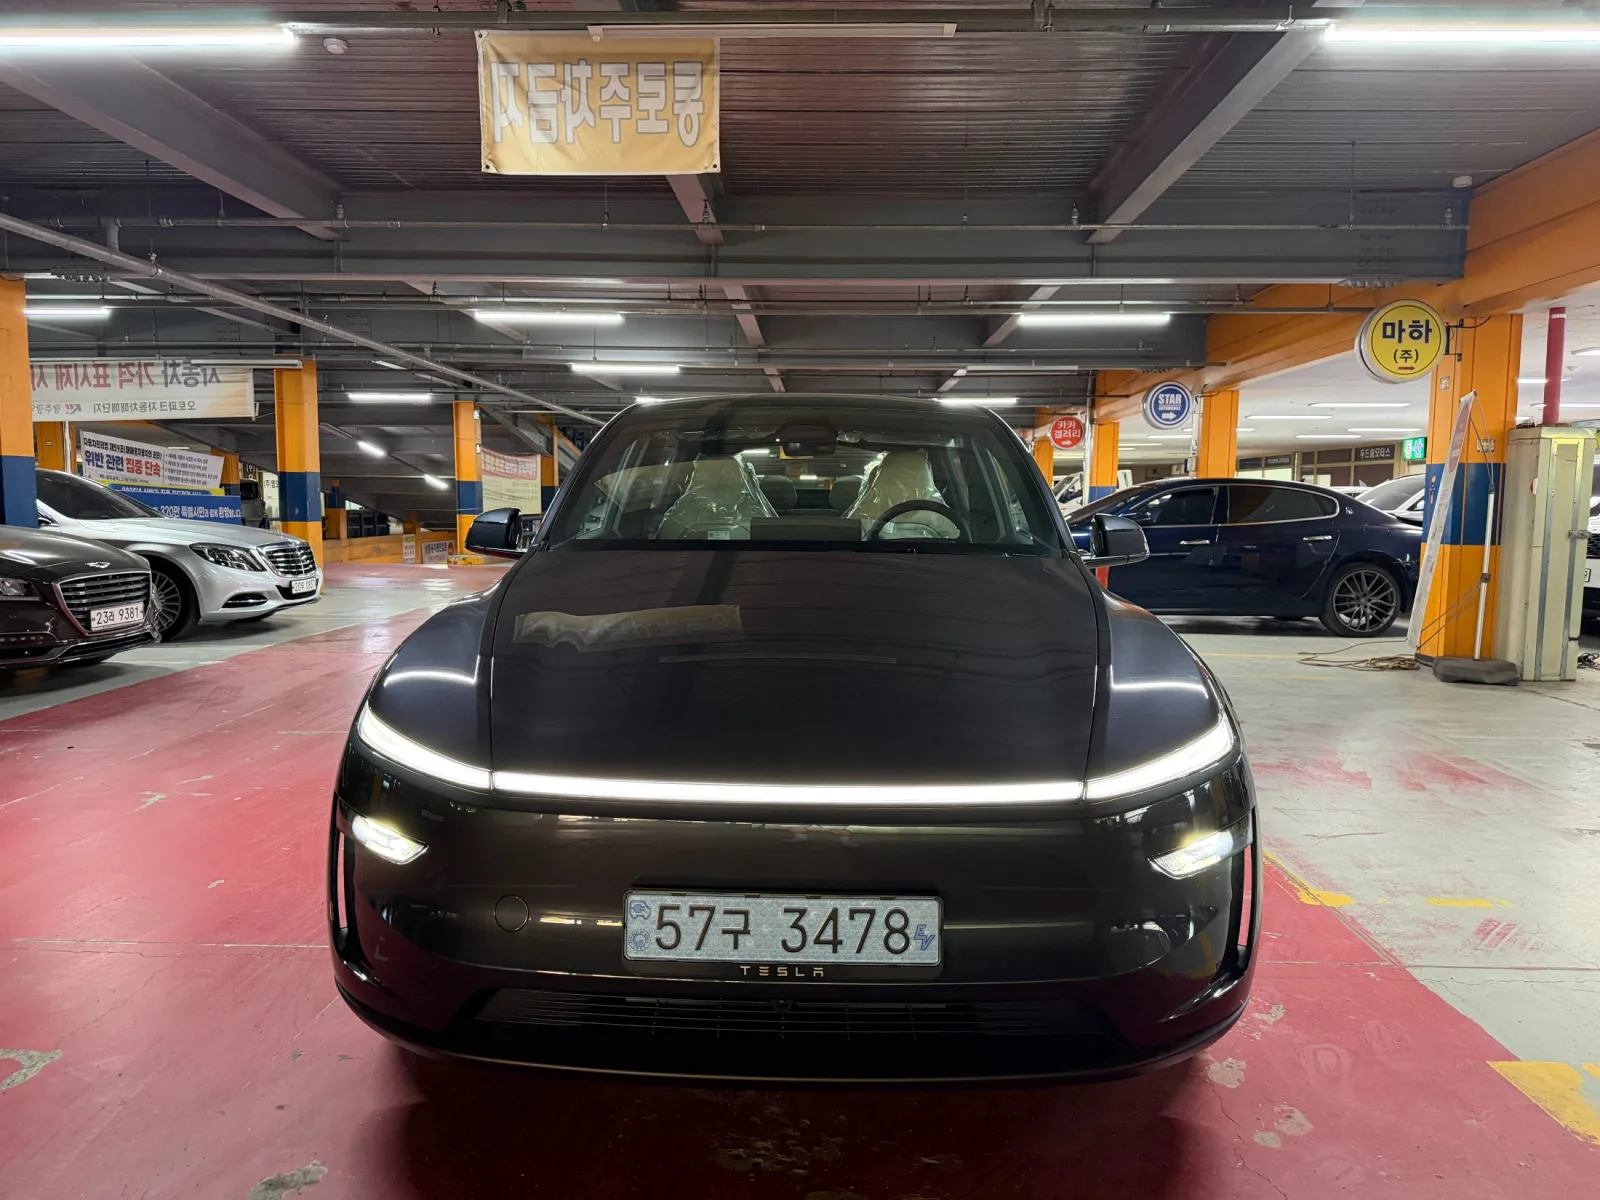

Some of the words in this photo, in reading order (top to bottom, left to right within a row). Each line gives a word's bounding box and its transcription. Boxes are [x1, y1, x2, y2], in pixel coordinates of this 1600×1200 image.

[1382, 319, 1432, 343] 마하
[1393, 348, 1419, 363] (주)
[1158, 393, 1182, 405] STAR
[1057, 420, 1077, 429] 카카
[1053, 429, 1081, 439] 갤러리
[84, 450, 104, 469] 위반
[105, 454, 124, 472] 관련
[125, 457, 143, 475] 집중
[144, 460, 161, 477] 단속
[96, 611, 115, 625] 23라
[118, 606, 139, 621] 9381
[654, 903, 751, 951] 57구
[781, 906, 911, 955] 3478
[739, 965, 824, 977] TESLA
